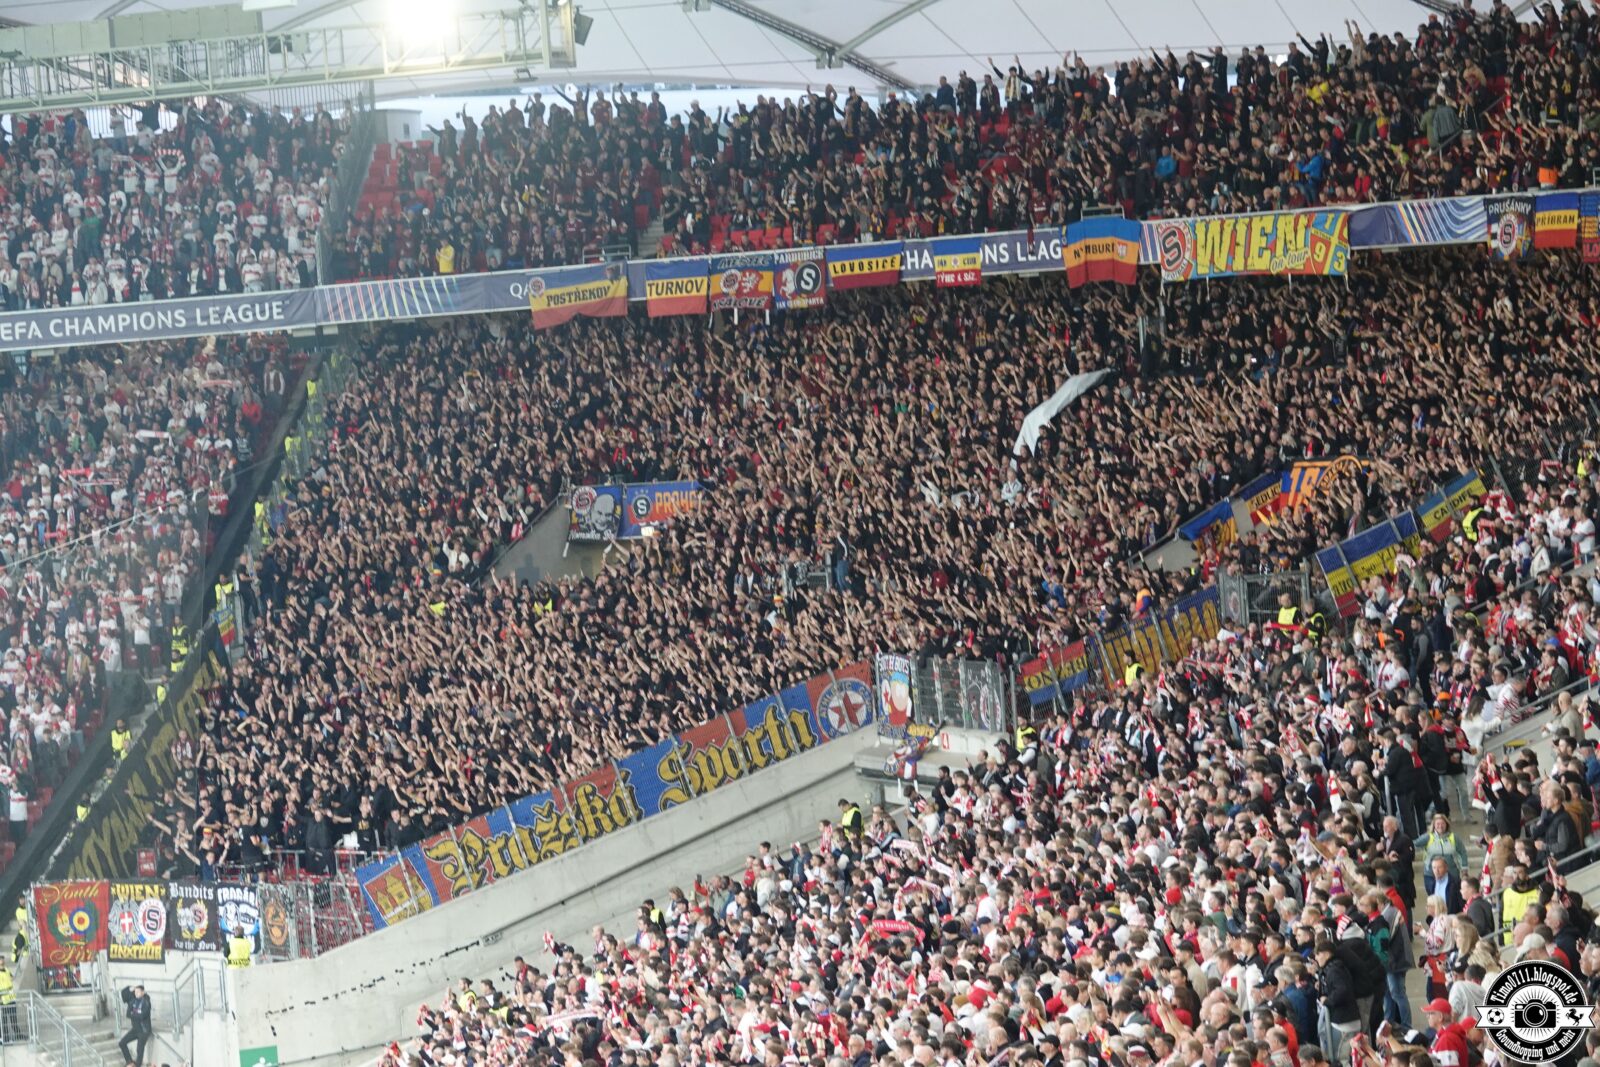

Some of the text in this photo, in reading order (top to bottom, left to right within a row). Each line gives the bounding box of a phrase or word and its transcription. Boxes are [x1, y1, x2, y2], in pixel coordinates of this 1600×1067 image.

[1196, 214, 1309, 275] WIEN
[648, 278, 703, 296] TURNOV
[49, 308, 187, 338] CHAMPIONS
[195, 299, 286, 327] LEAGUE
[657, 703, 819, 812] Sparta
[168, 882, 214, 900] Bandits
